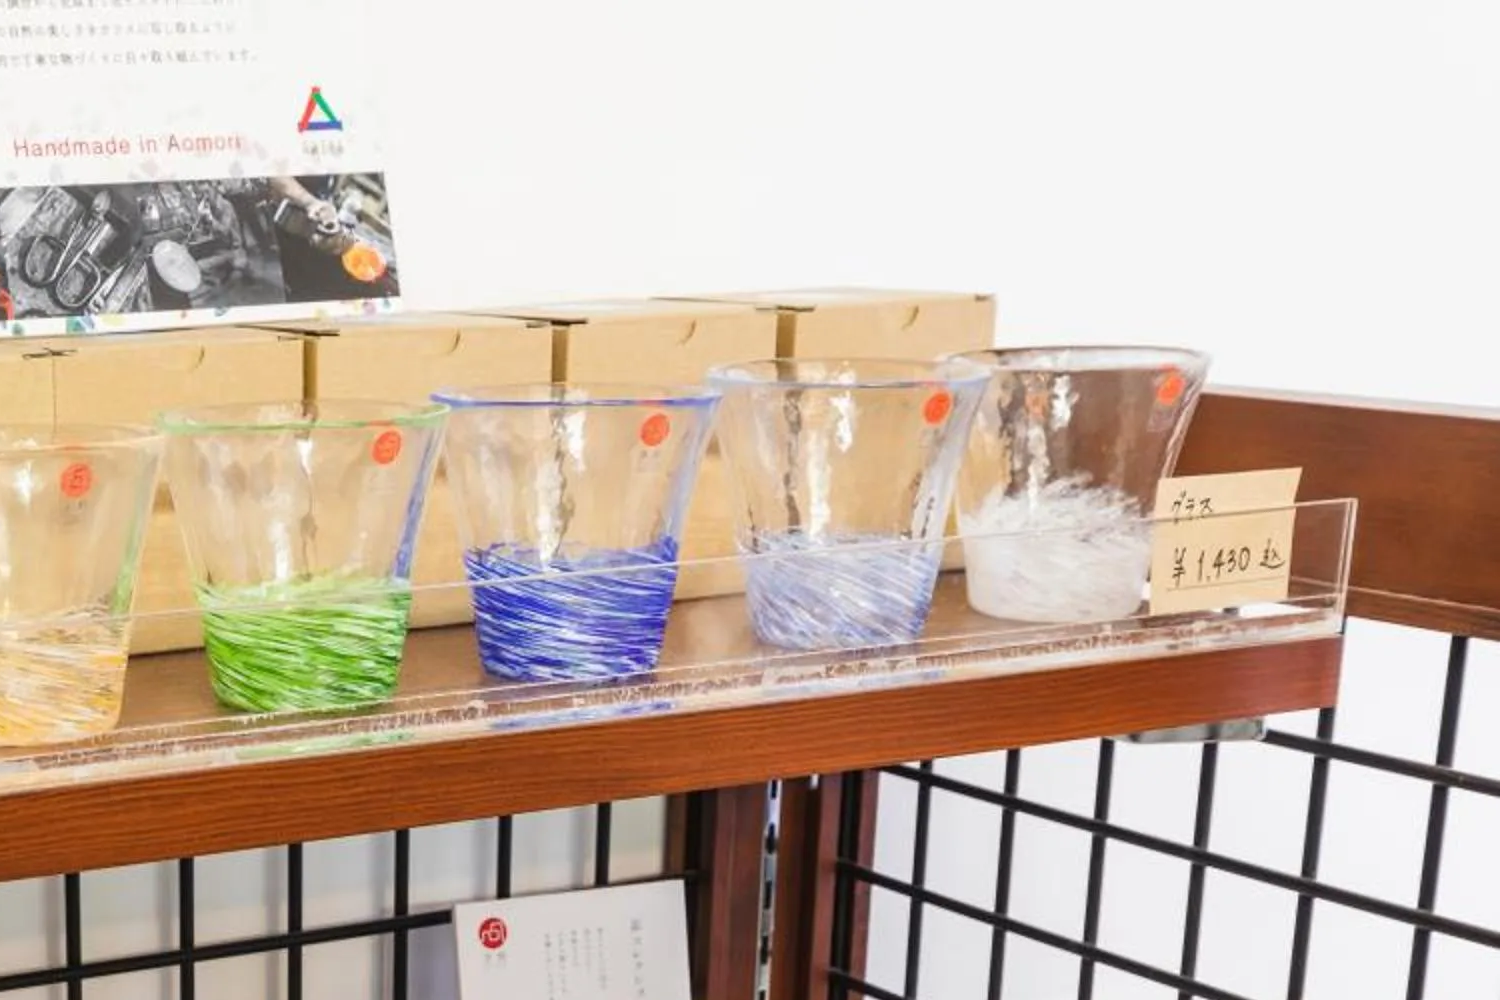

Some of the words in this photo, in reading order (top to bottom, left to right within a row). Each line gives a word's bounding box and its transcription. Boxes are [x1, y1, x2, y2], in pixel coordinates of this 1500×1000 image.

[13, 138, 130, 158] Handmade
[139, 136, 157, 153] in
[167, 132, 243, 152] Aomori
